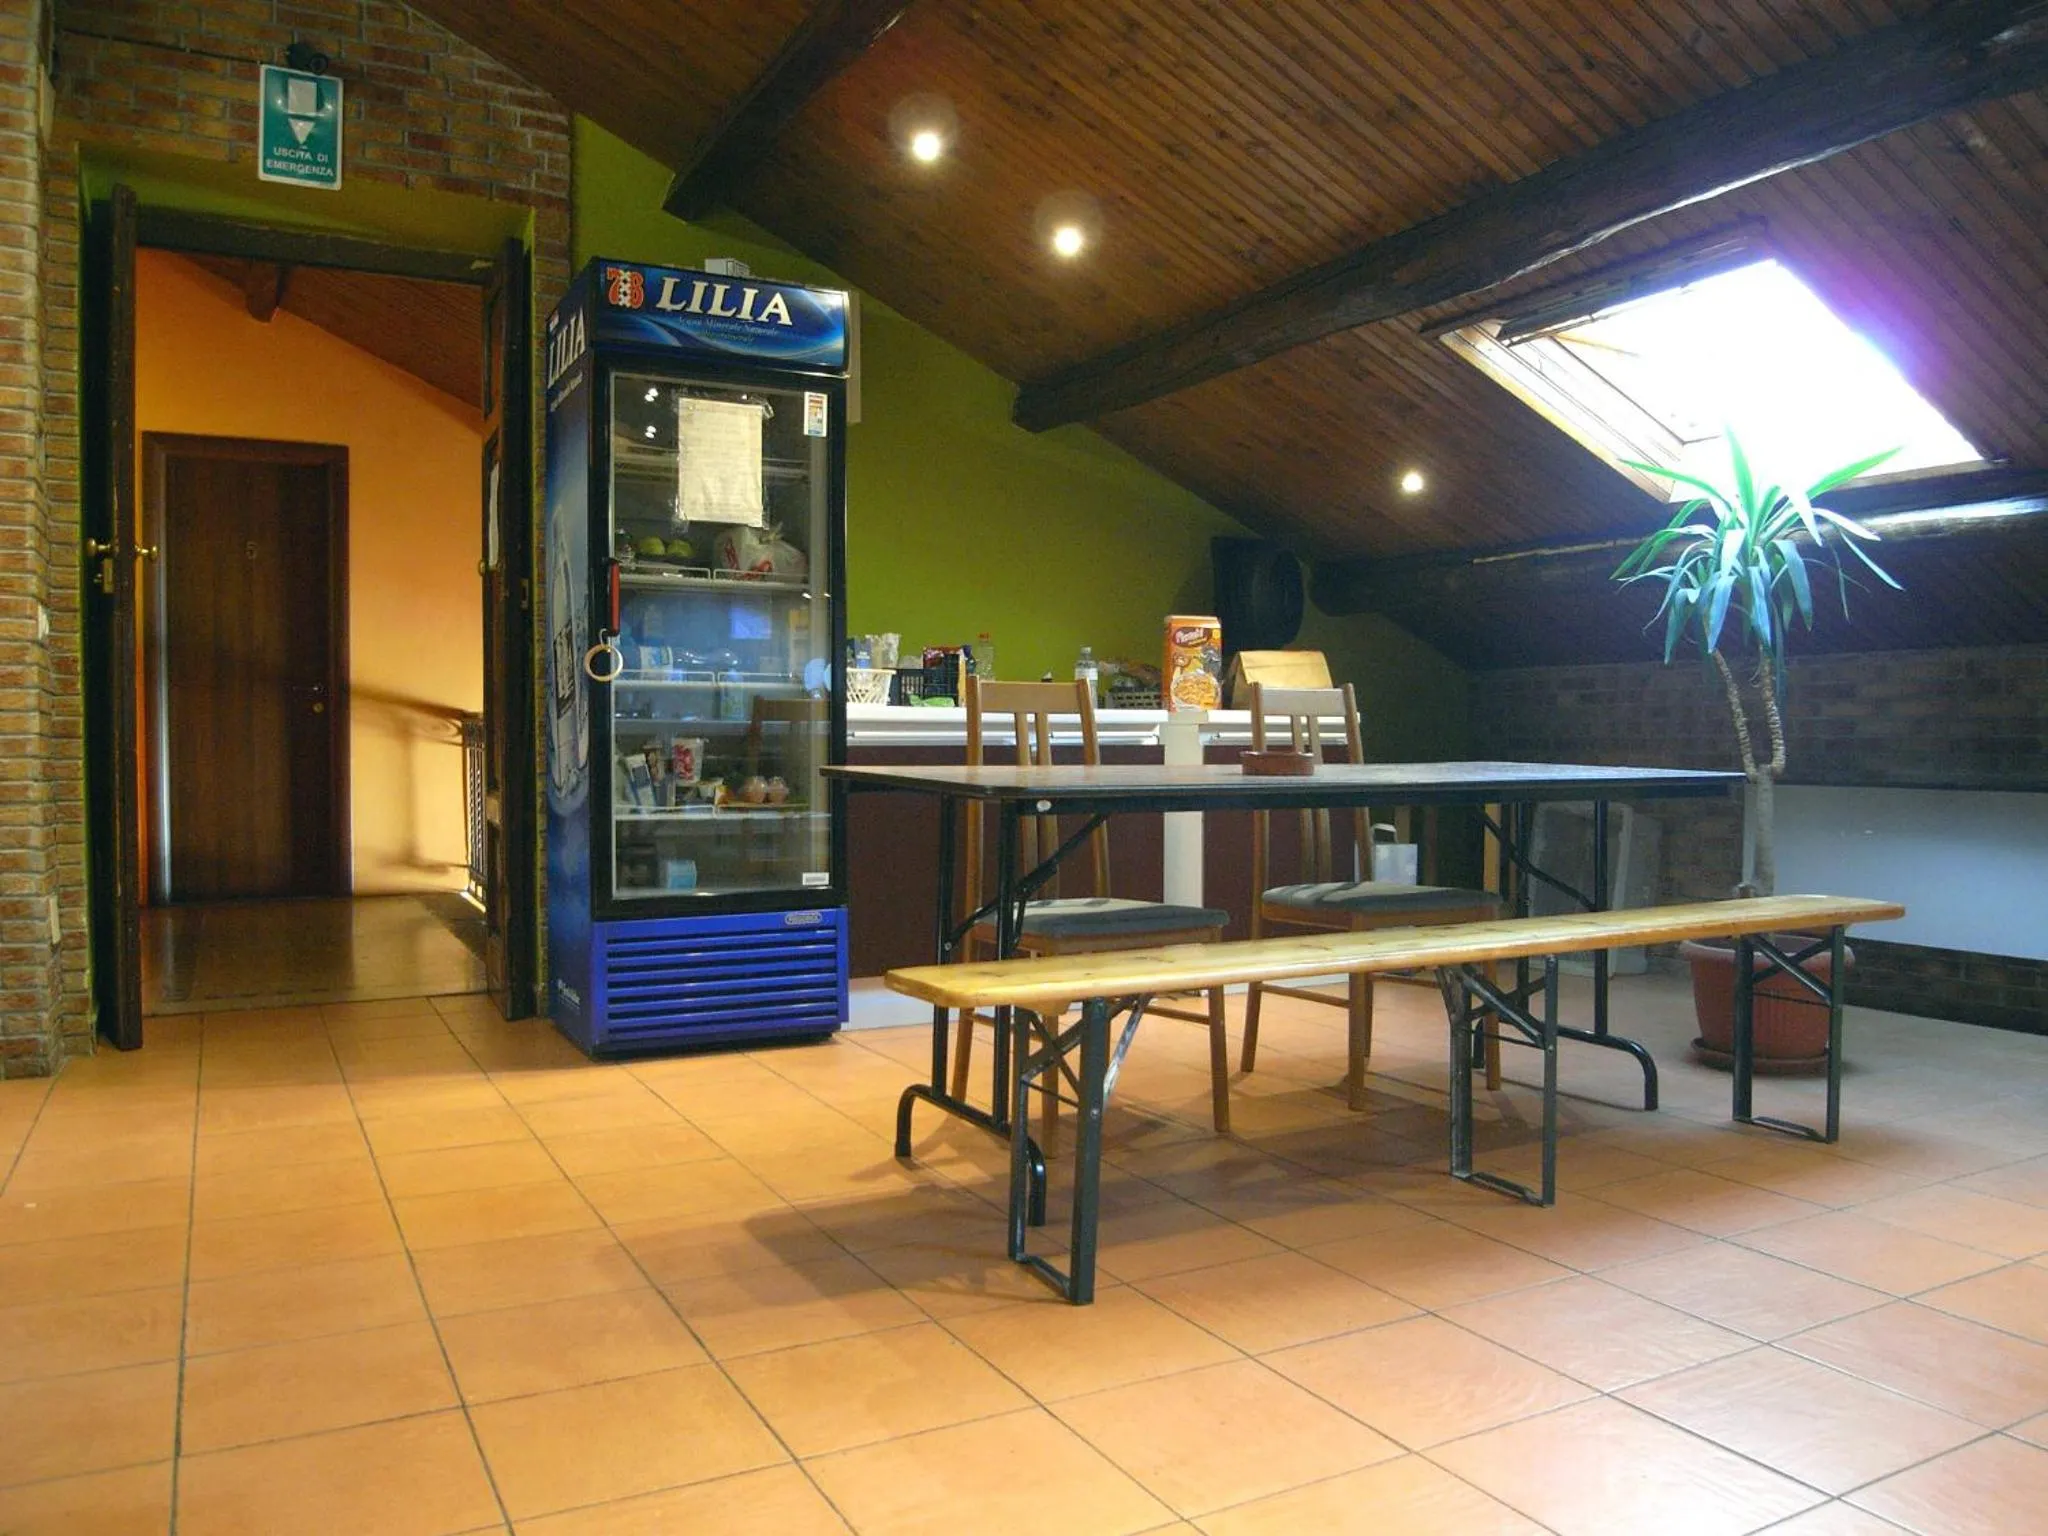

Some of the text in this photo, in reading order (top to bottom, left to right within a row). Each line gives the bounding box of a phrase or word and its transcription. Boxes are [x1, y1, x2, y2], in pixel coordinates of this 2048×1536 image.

[266, 159, 334, 177] EMERGENZA
[273, 147, 329, 163] USCITA DI
[655, 276, 793, 326] LILIA
[547, 306, 586, 390] LILIA
